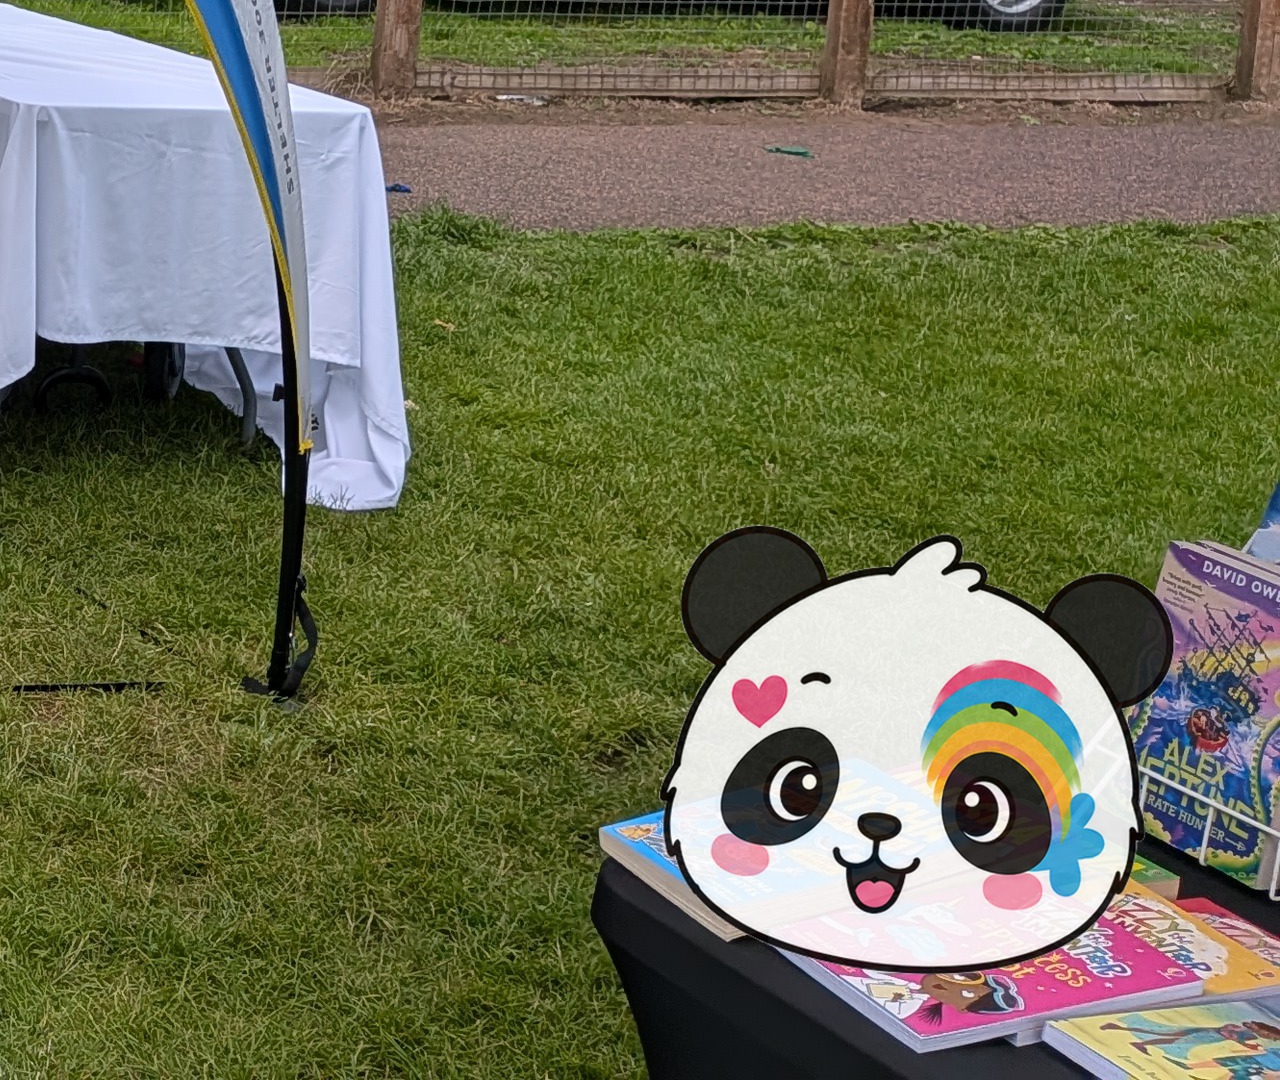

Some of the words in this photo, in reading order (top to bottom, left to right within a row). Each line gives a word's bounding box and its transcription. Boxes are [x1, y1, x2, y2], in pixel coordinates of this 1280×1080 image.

[264, 54, 295, 195] SHELTER
[1202, 560, 1247, 588] DAVID
[1164, 737, 1229, 790] ALEX
